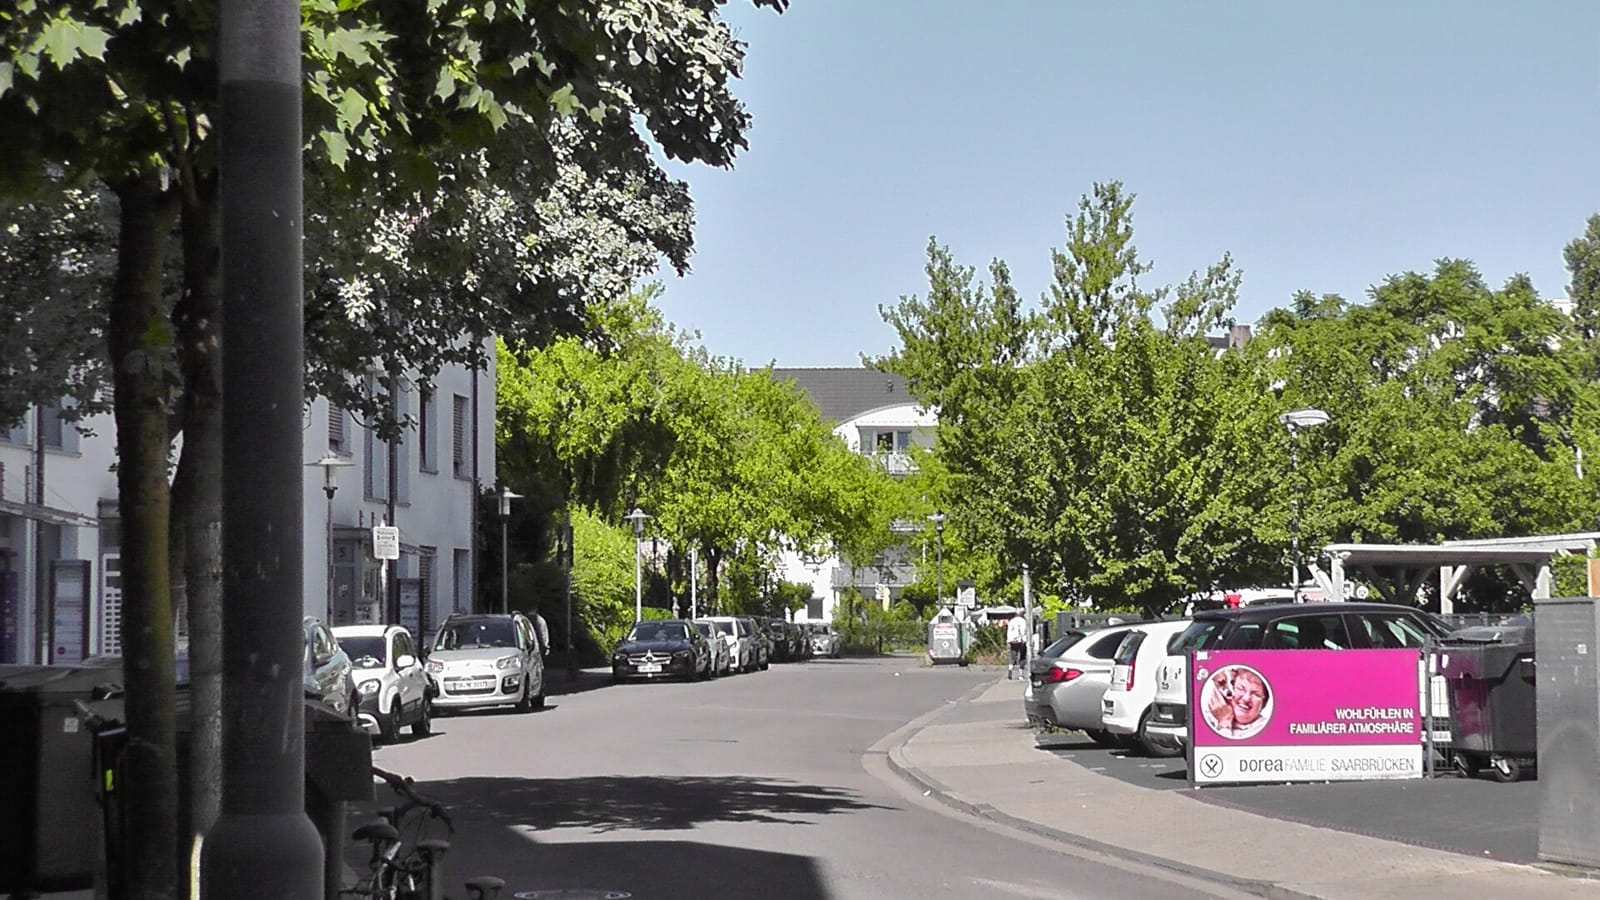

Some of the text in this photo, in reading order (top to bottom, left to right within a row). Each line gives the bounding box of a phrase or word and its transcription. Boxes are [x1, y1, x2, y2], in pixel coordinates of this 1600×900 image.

[1335, 707, 1414, 719] WOHLFÜHLEN IN
[1289, 721, 1414, 734] FAMILIÄRER ATMOSPHÄRE
[1331, 756, 1414, 771] SAARBRÜCKEN
